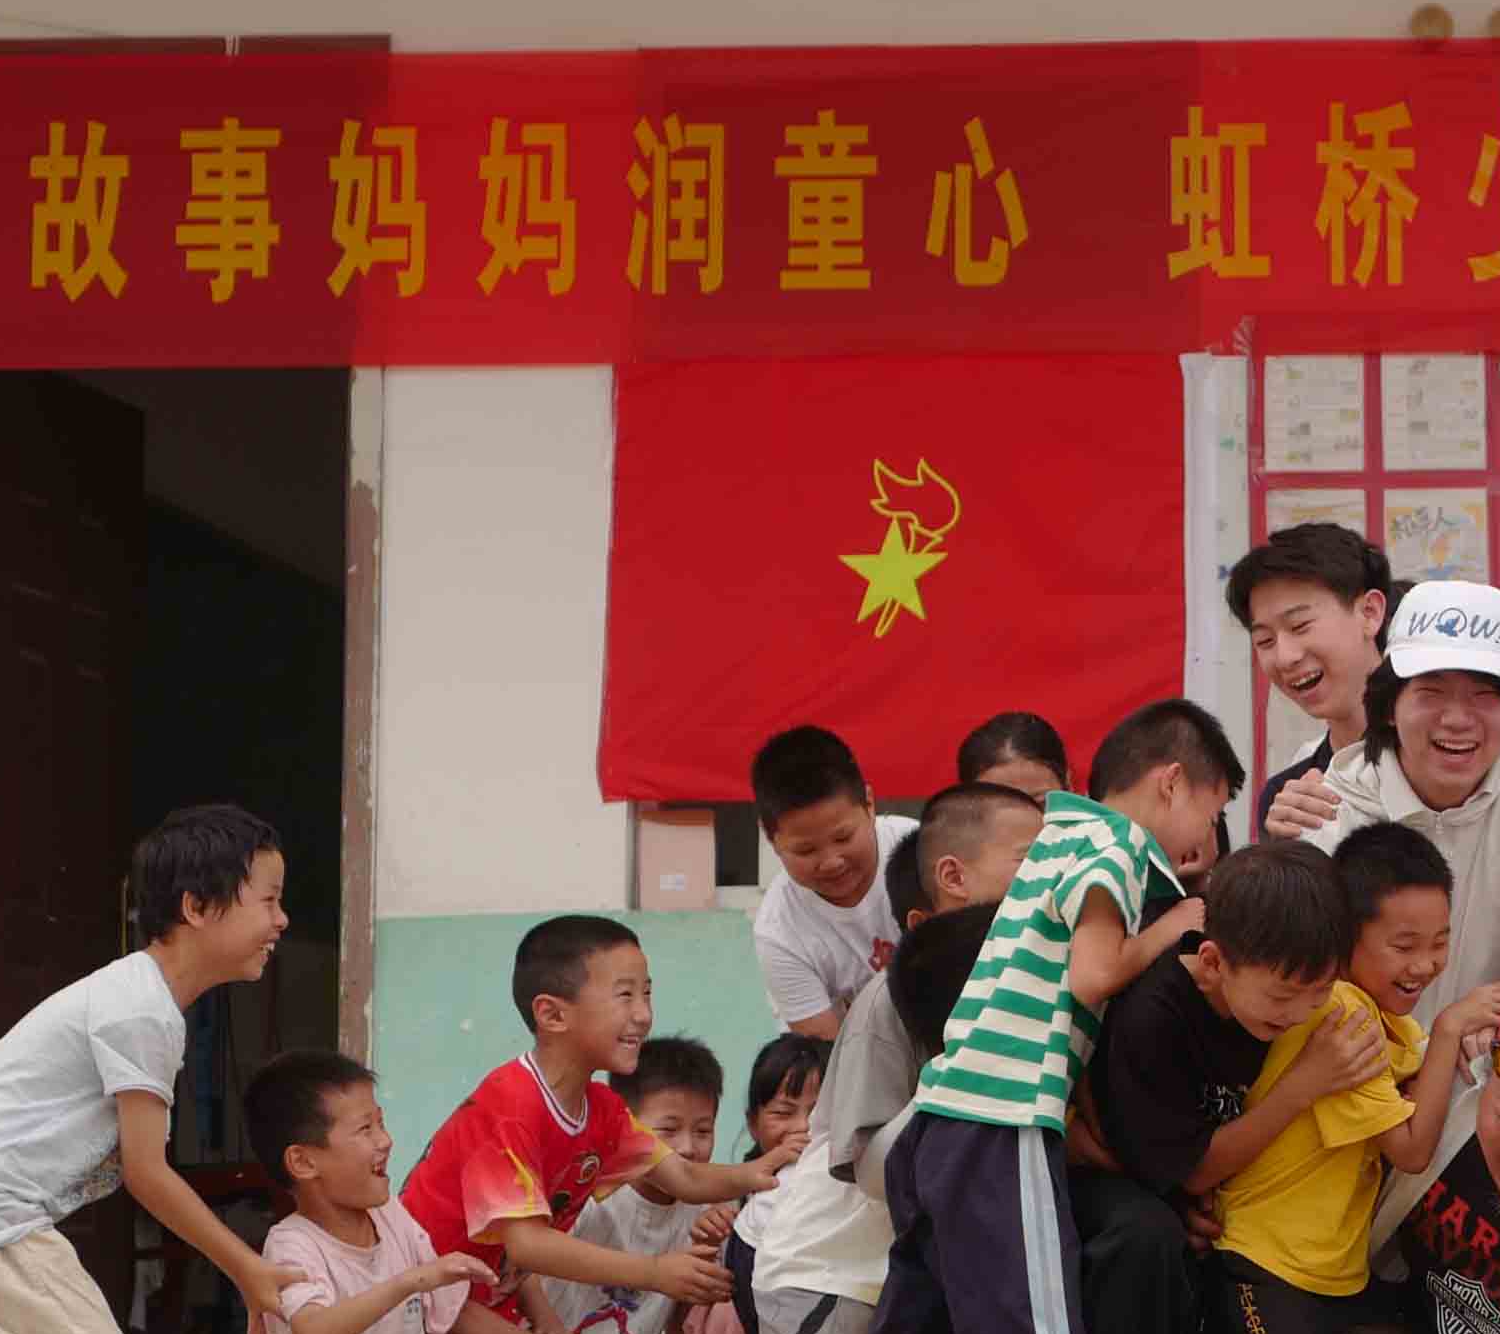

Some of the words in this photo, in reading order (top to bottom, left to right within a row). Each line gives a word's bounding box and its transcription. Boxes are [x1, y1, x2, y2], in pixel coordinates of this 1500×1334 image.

[28, 110, 1029, 303] 故事妈妈润童心
